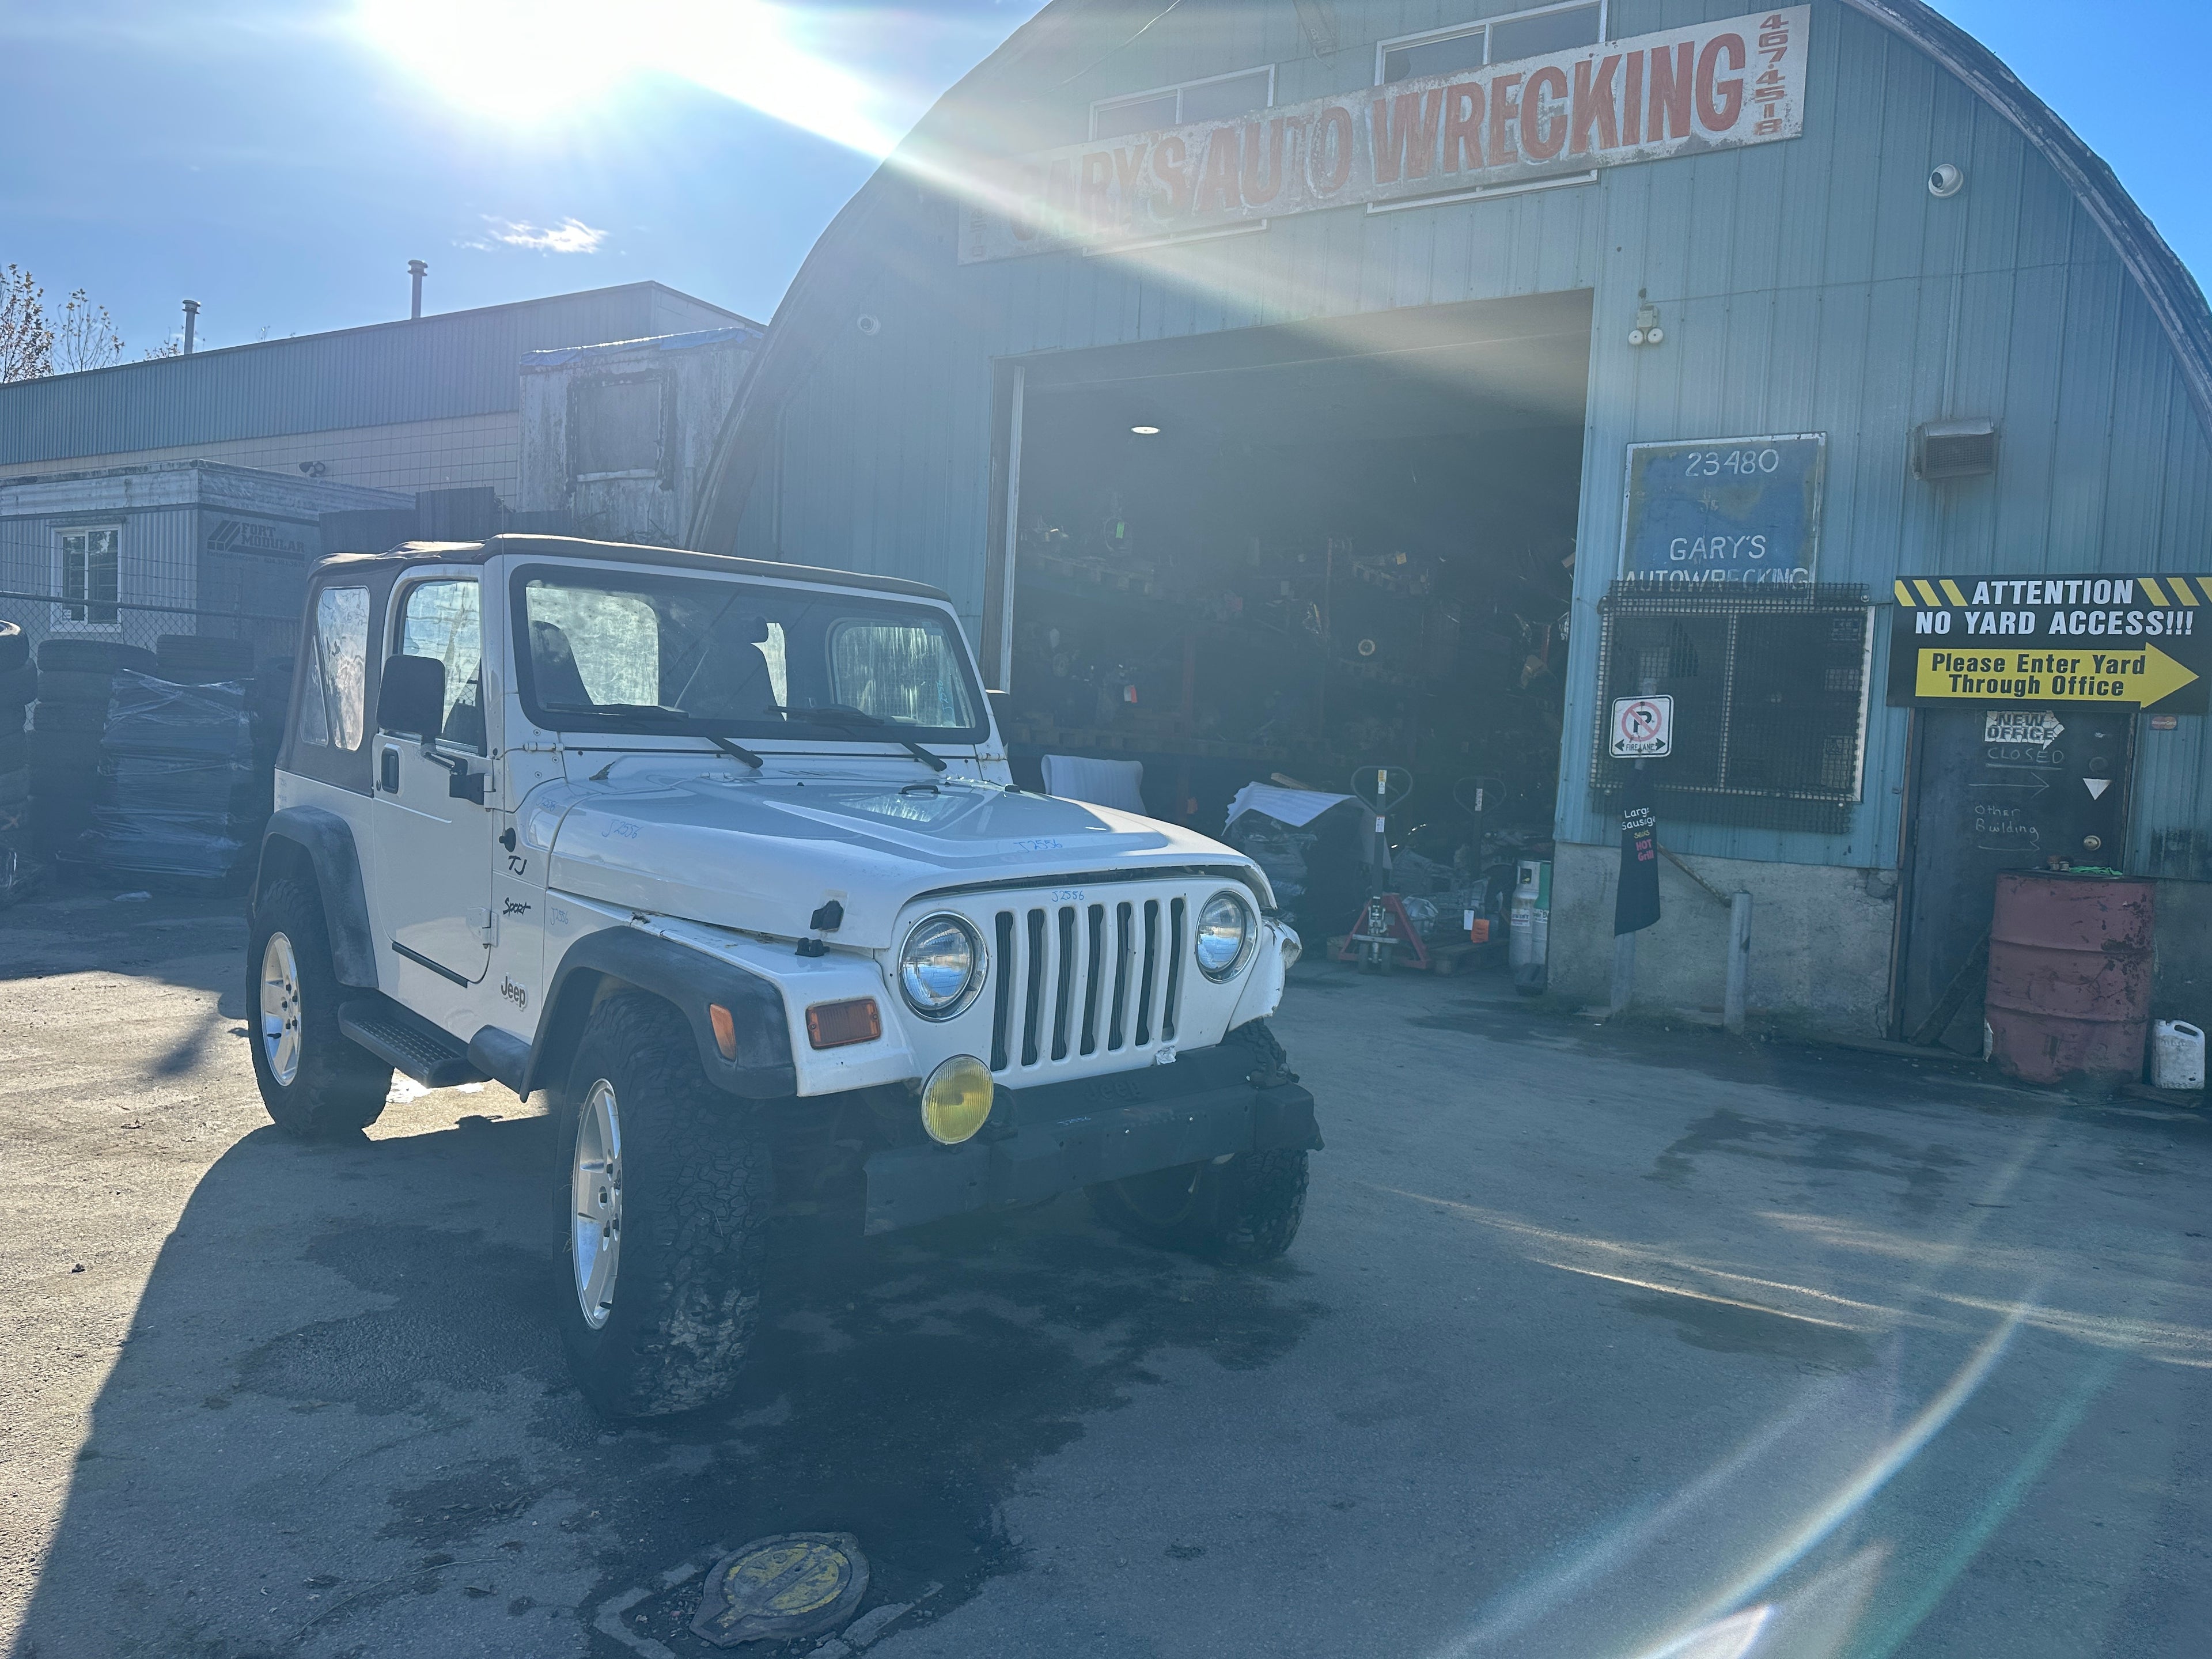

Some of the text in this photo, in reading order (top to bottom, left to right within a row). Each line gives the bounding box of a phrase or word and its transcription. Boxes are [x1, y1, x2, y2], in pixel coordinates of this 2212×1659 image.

[1198, 106, 1354, 213] AUTO
[1375, 33, 1745, 183] WRECKING
[1685, 449, 1779, 477] 23480
[241, 522, 276, 537] FORT
[241, 534, 305, 552] MODULAR
[1670, 535, 1766, 561] GARY'S
[1971, 579, 2134, 605] ATTENTION
[1915, 611, 2194, 635] NO YARD ACCESS!!!
[1931, 653, 2146, 675] Please Enter Yard
[1949, 674, 2124, 698] Through Office
[1997, 713, 2044, 726] NEW
[1987, 726, 2055, 741] OFFICE
[1988, 747, 2064, 764] CLOSED
[1624, 807, 1650, 818] Large
[601, 819, 645, 839] J2556
[1622, 816, 1656, 831] Sausage
[1975, 817, 2040, 841] Building
[1013, 838, 1063, 853] J2556
[1635, 839, 1652, 851] HOT
[507, 855, 528, 876] TJ
[1638, 850, 1654, 862] Grill
[1051, 890, 1085, 902] J2556
[501, 974, 528, 1009] Jeep
